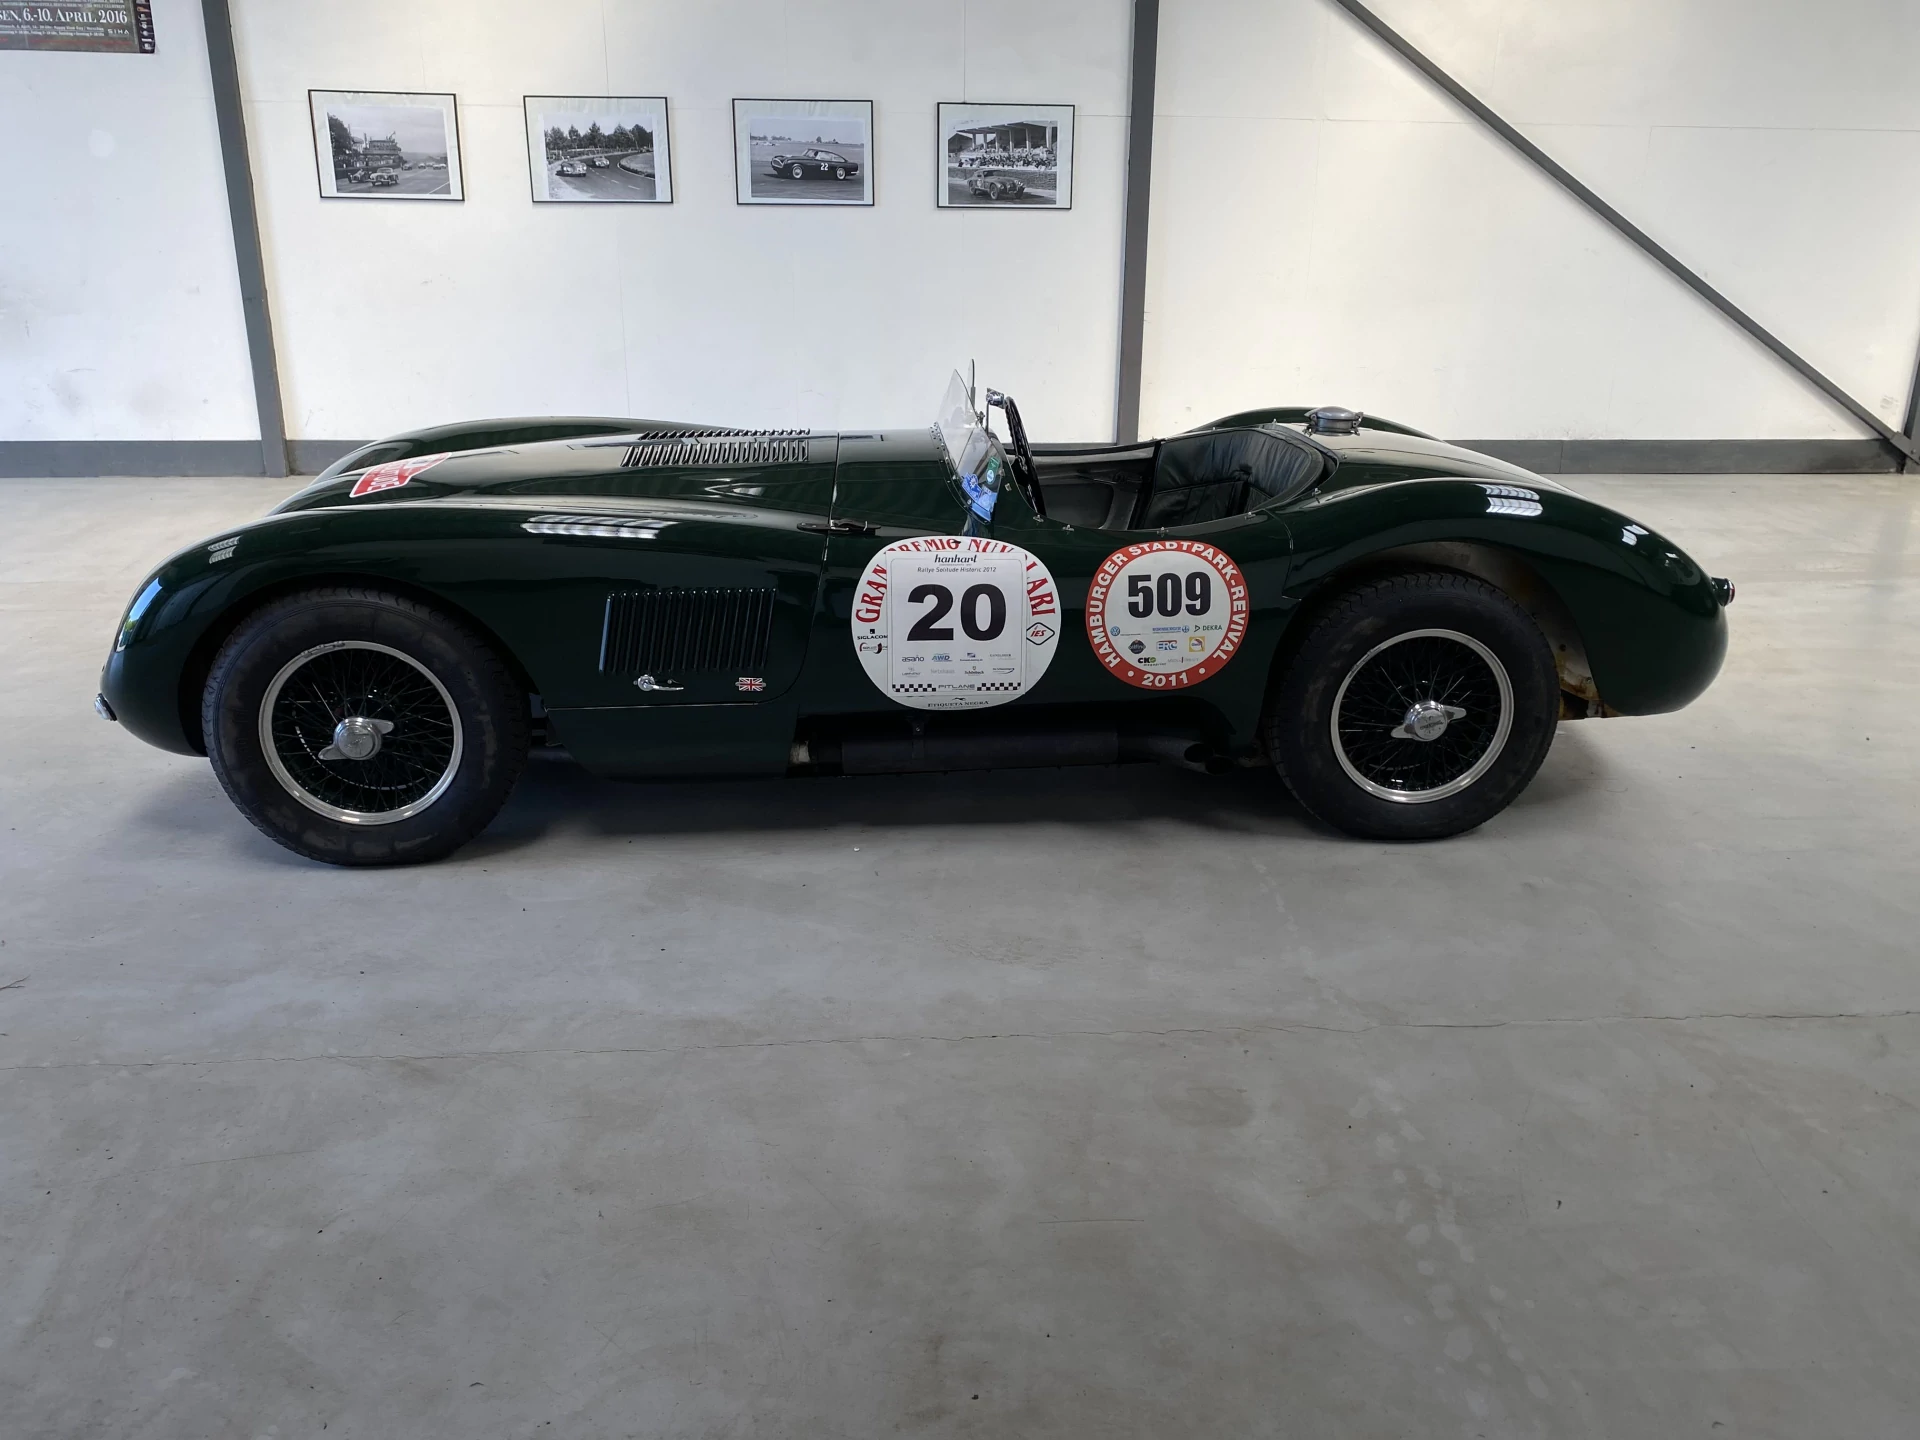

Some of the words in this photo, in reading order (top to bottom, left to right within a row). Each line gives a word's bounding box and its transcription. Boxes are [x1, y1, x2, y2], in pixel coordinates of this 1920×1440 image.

[23, 7, 53, 22] 6.-10.
[98, 9, 128, 24] 2016
[820, 163, 829, 171] 22
[934, 554, 978, 563] hanhart
[856, 564, 888, 623] GRAN
[1089, 553, 1128, 668] HAMBURGER
[1128, 541, 1246, 660] STADTPARK-REVIVAL
[1128, 571, 1212, 618] 509
[907, 584, 1006, 641] 20
[1141, 672, 1189, 686] 2011
